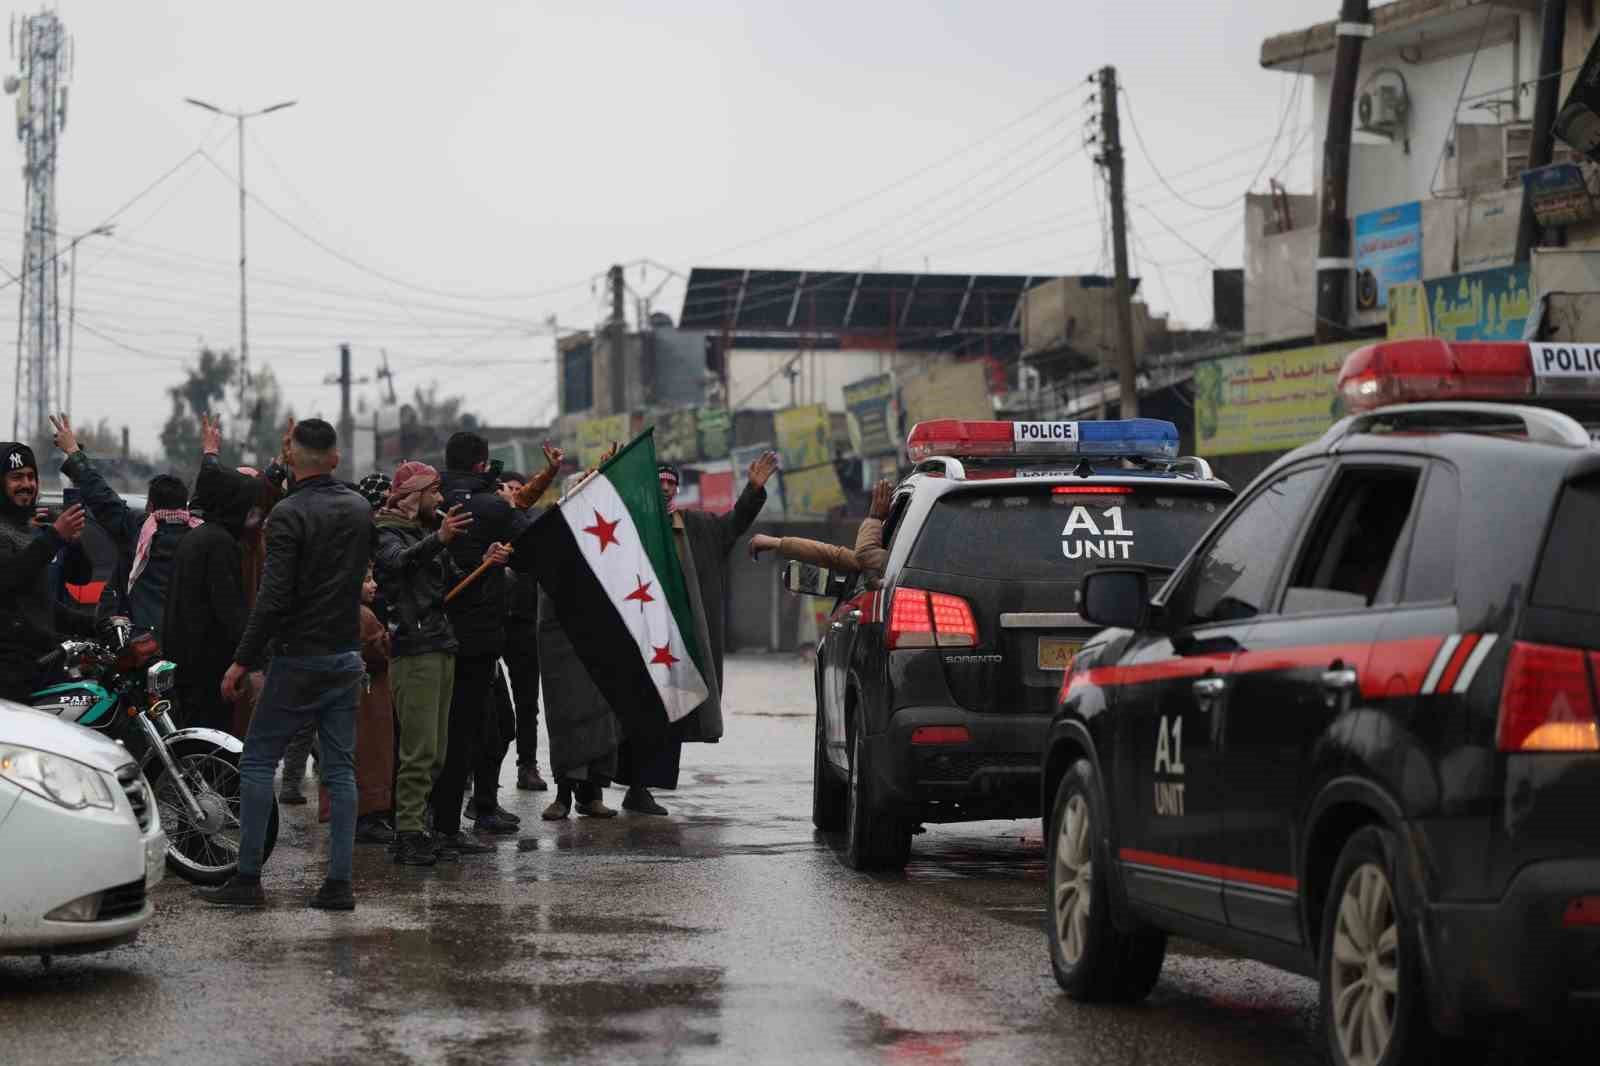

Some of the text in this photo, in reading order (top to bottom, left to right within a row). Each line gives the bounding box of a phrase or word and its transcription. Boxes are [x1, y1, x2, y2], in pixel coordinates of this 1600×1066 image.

[1021, 424, 1072, 439] POLICE
[1061, 506, 1134, 536] A1
[1061, 540, 1134, 559] UNIT
[944, 654, 1002, 664] SORENTO
[1154, 715, 1184, 773] A1
[1154, 783, 1184, 816] UNIT
